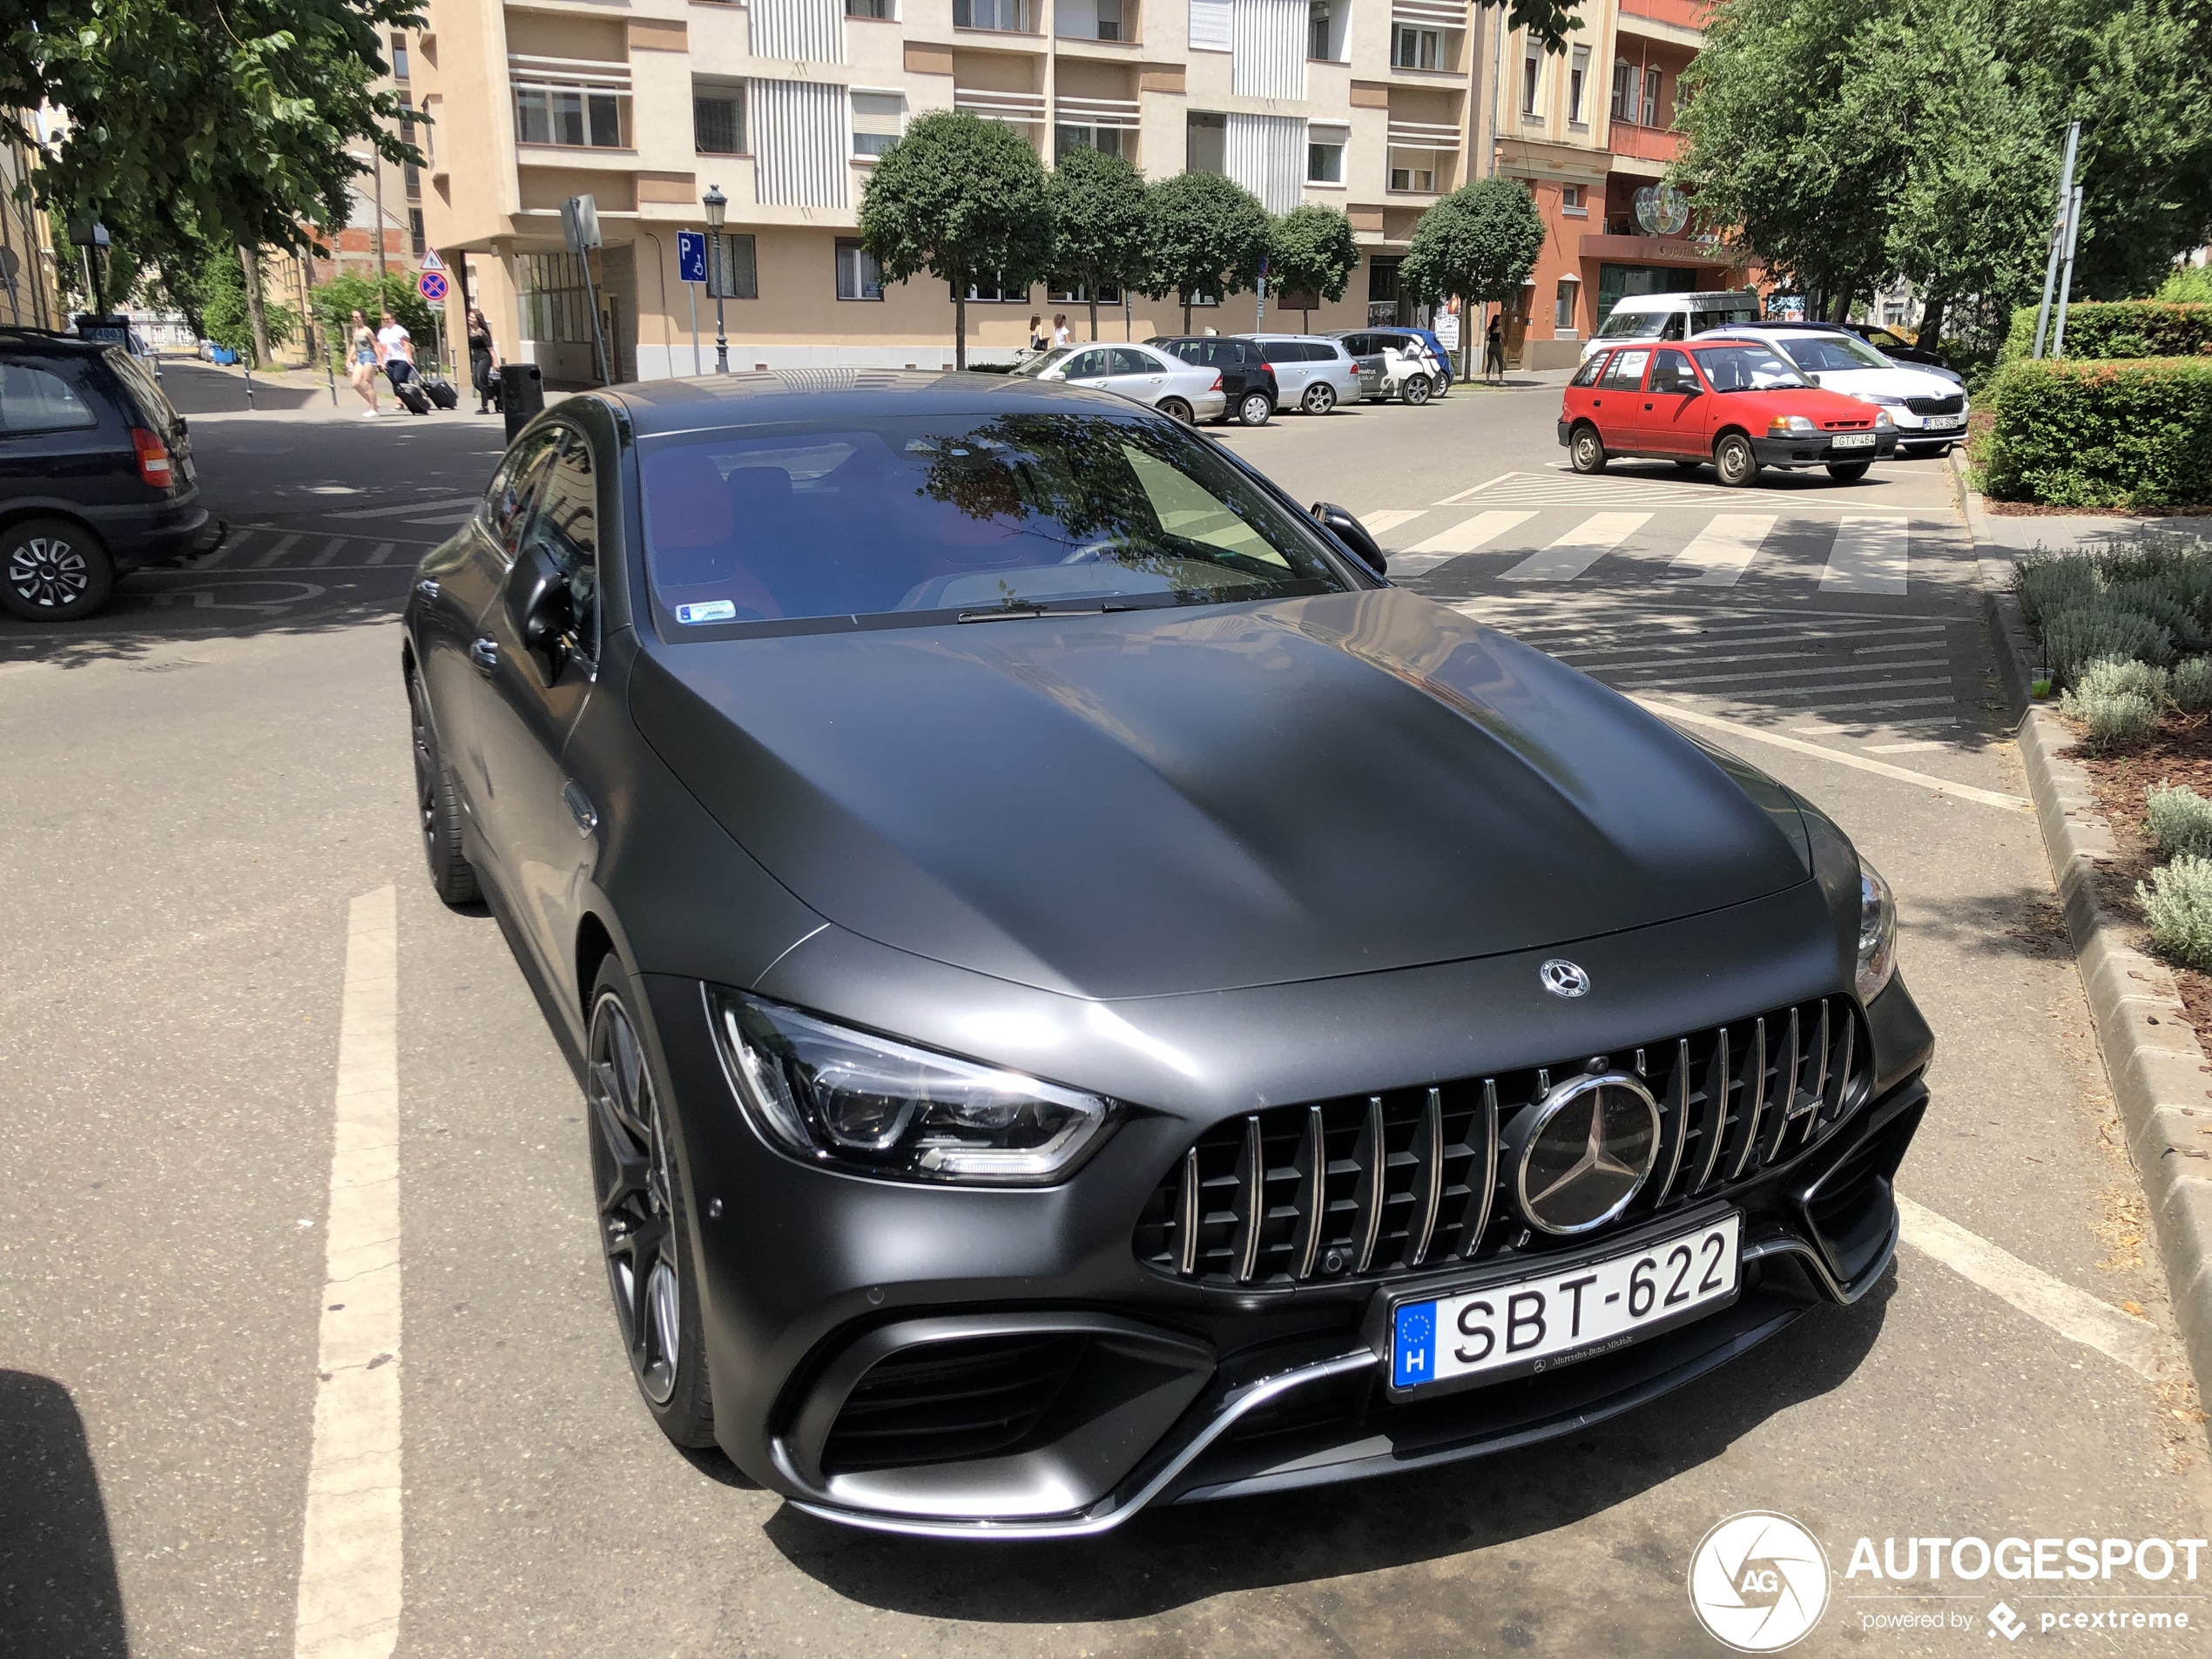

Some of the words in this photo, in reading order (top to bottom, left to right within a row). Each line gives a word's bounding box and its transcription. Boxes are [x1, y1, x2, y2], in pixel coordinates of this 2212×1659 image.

[680, 238, 691, 260] P
[97, 329, 124, 339] 4003
[1839, 435, 1874, 446] GTV-464
[1406, 1348, 1425, 1373] H
[1453, 1231, 1725, 1364] SBT-622
[1553, 1345, 1605, 1366] Mercedes-Benz
